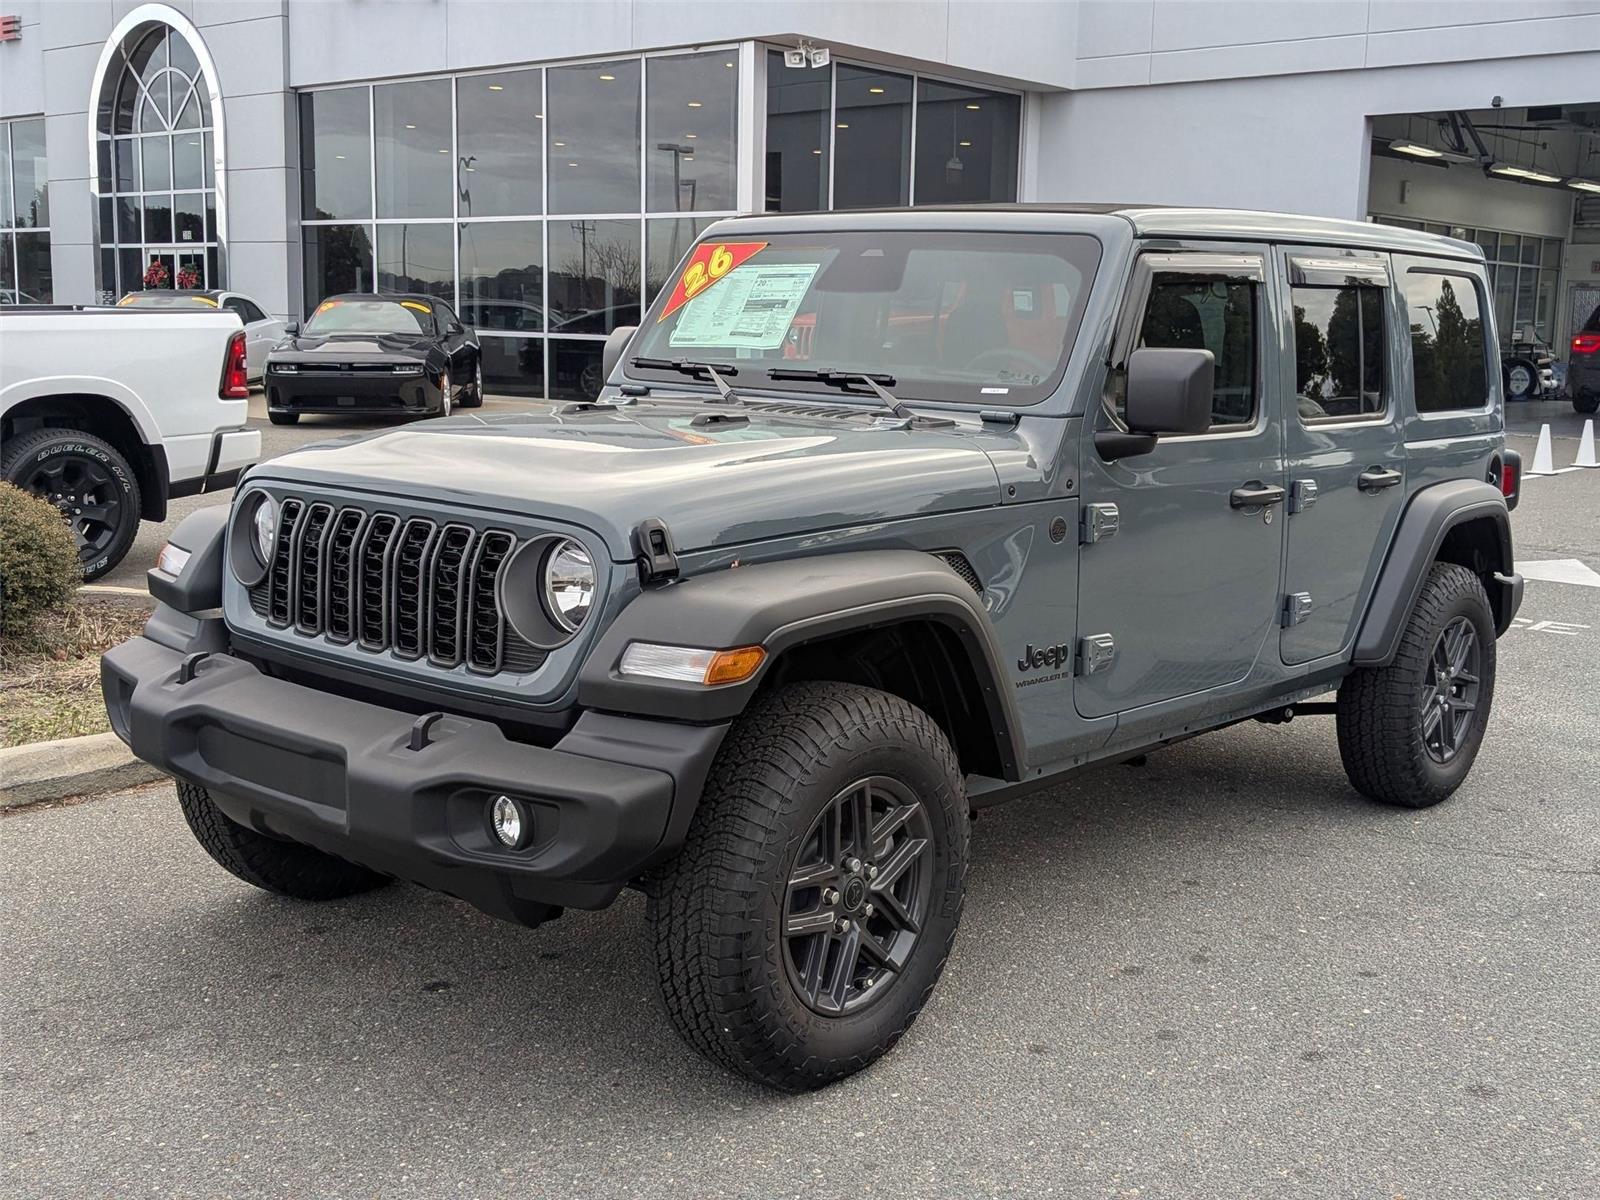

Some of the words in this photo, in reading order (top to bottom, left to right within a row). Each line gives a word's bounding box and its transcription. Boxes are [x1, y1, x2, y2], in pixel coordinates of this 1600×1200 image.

[683, 245, 734, 298] 26
[1017, 643, 1069, 672] Jeep
[1016, 673, 1061, 689] WRANGLER
